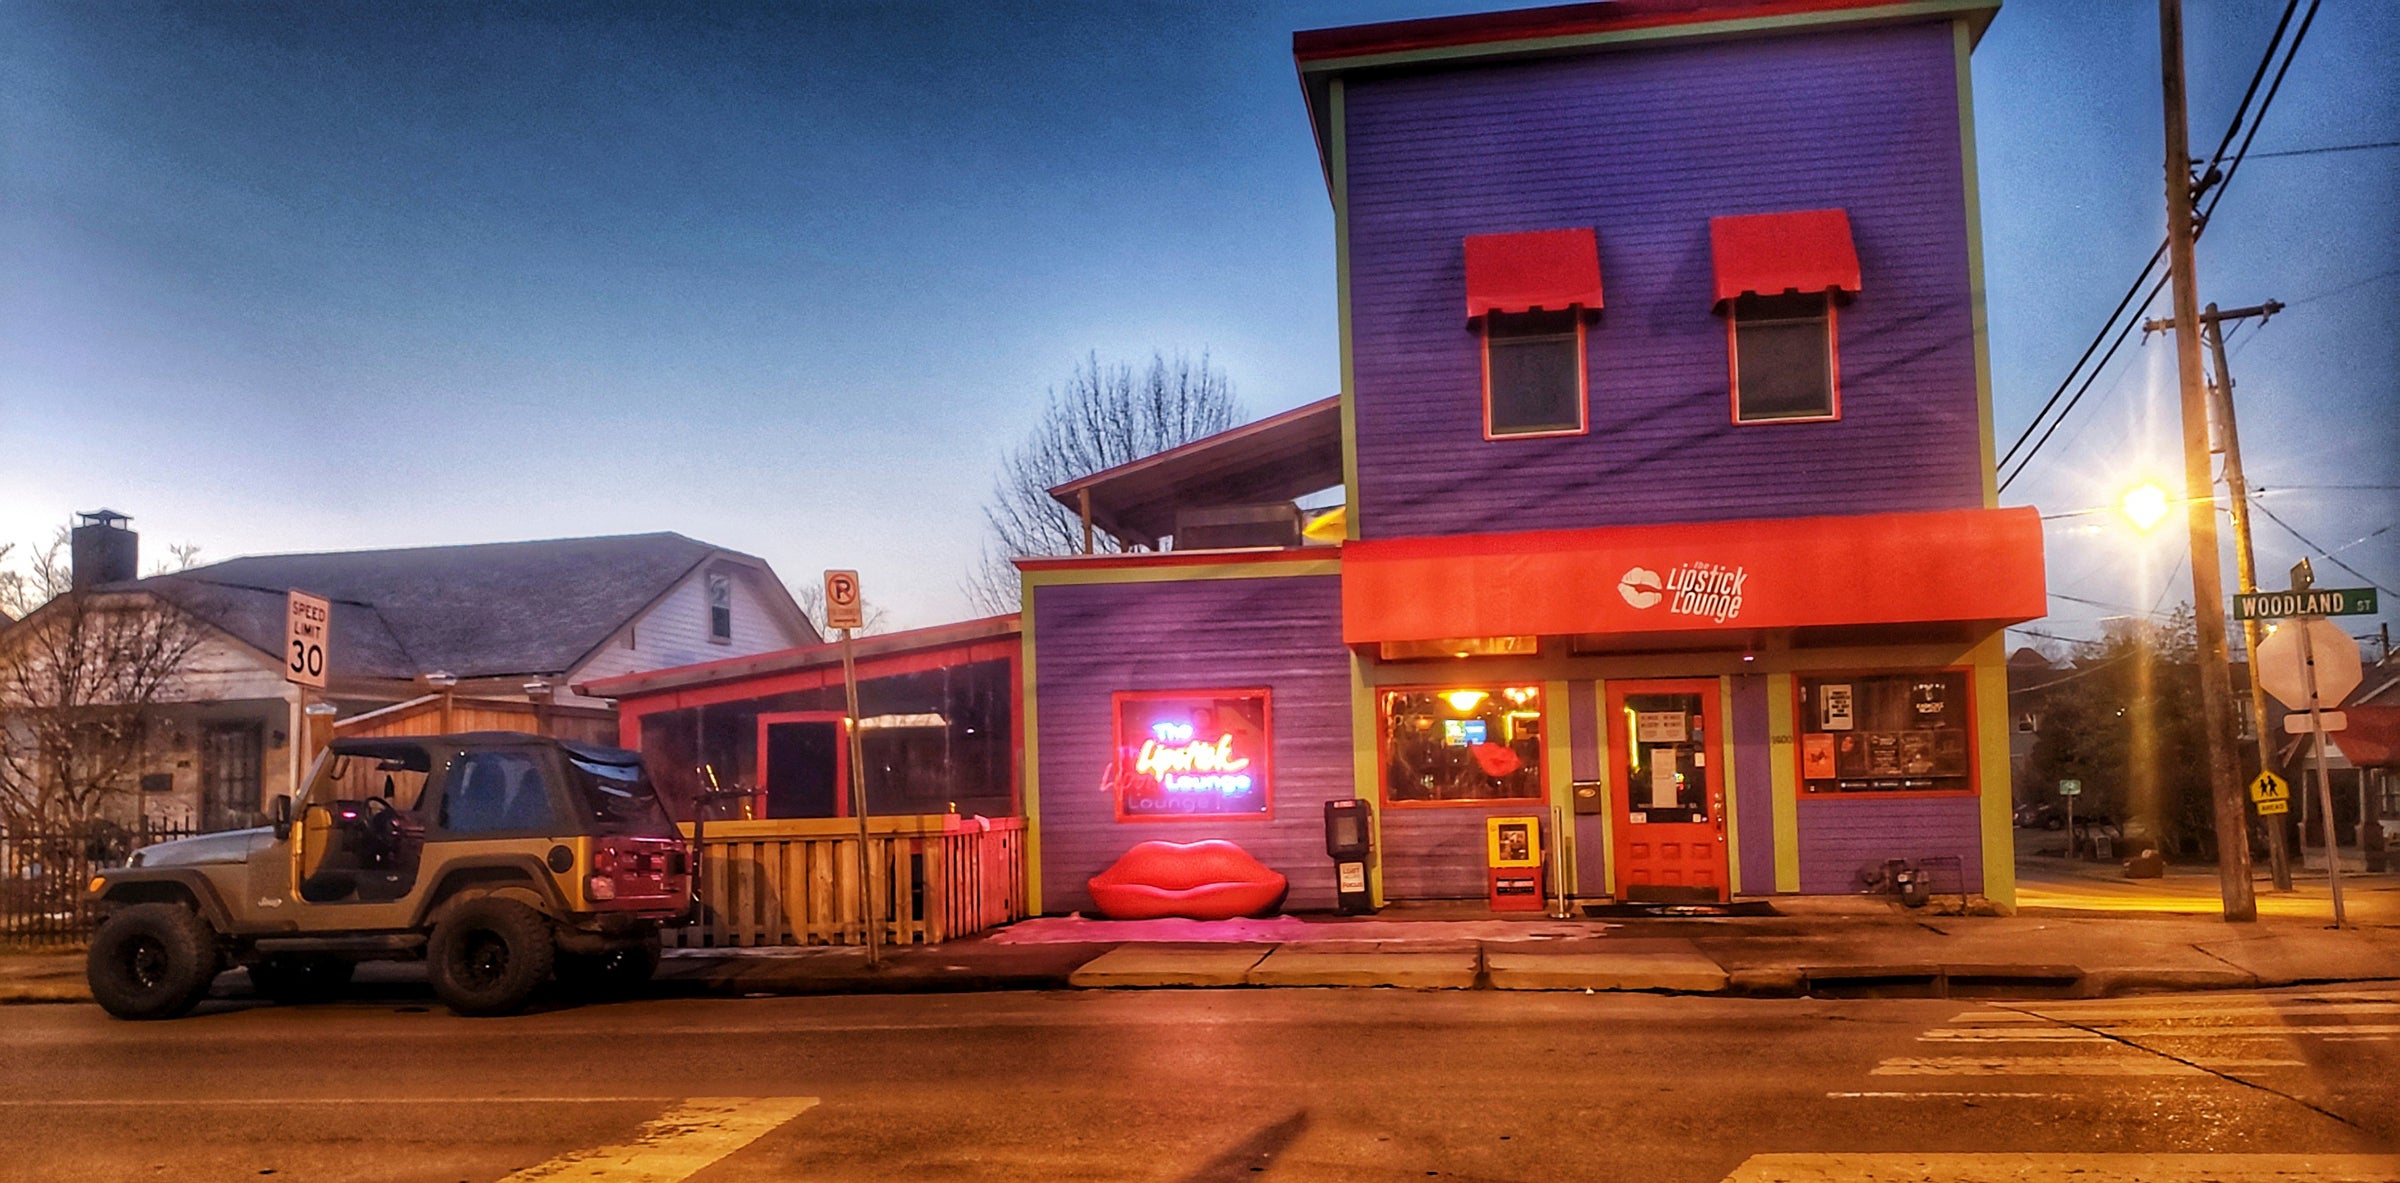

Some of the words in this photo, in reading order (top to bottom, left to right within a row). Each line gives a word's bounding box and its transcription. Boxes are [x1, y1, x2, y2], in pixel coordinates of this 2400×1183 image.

[1666, 562, 1748, 598] Lipstick
[293, 601, 326, 622] SPEED
[1670, 591, 1743, 624] Lounge
[2242, 592, 2344, 617] WOODLAND
[2356, 600, 2372, 612] ST
[294, 621, 321, 639] LIMIT
[290, 640, 323, 677] 30
[1152, 721, 1194, 741] The
[1164, 773, 1251, 795] Lounge
